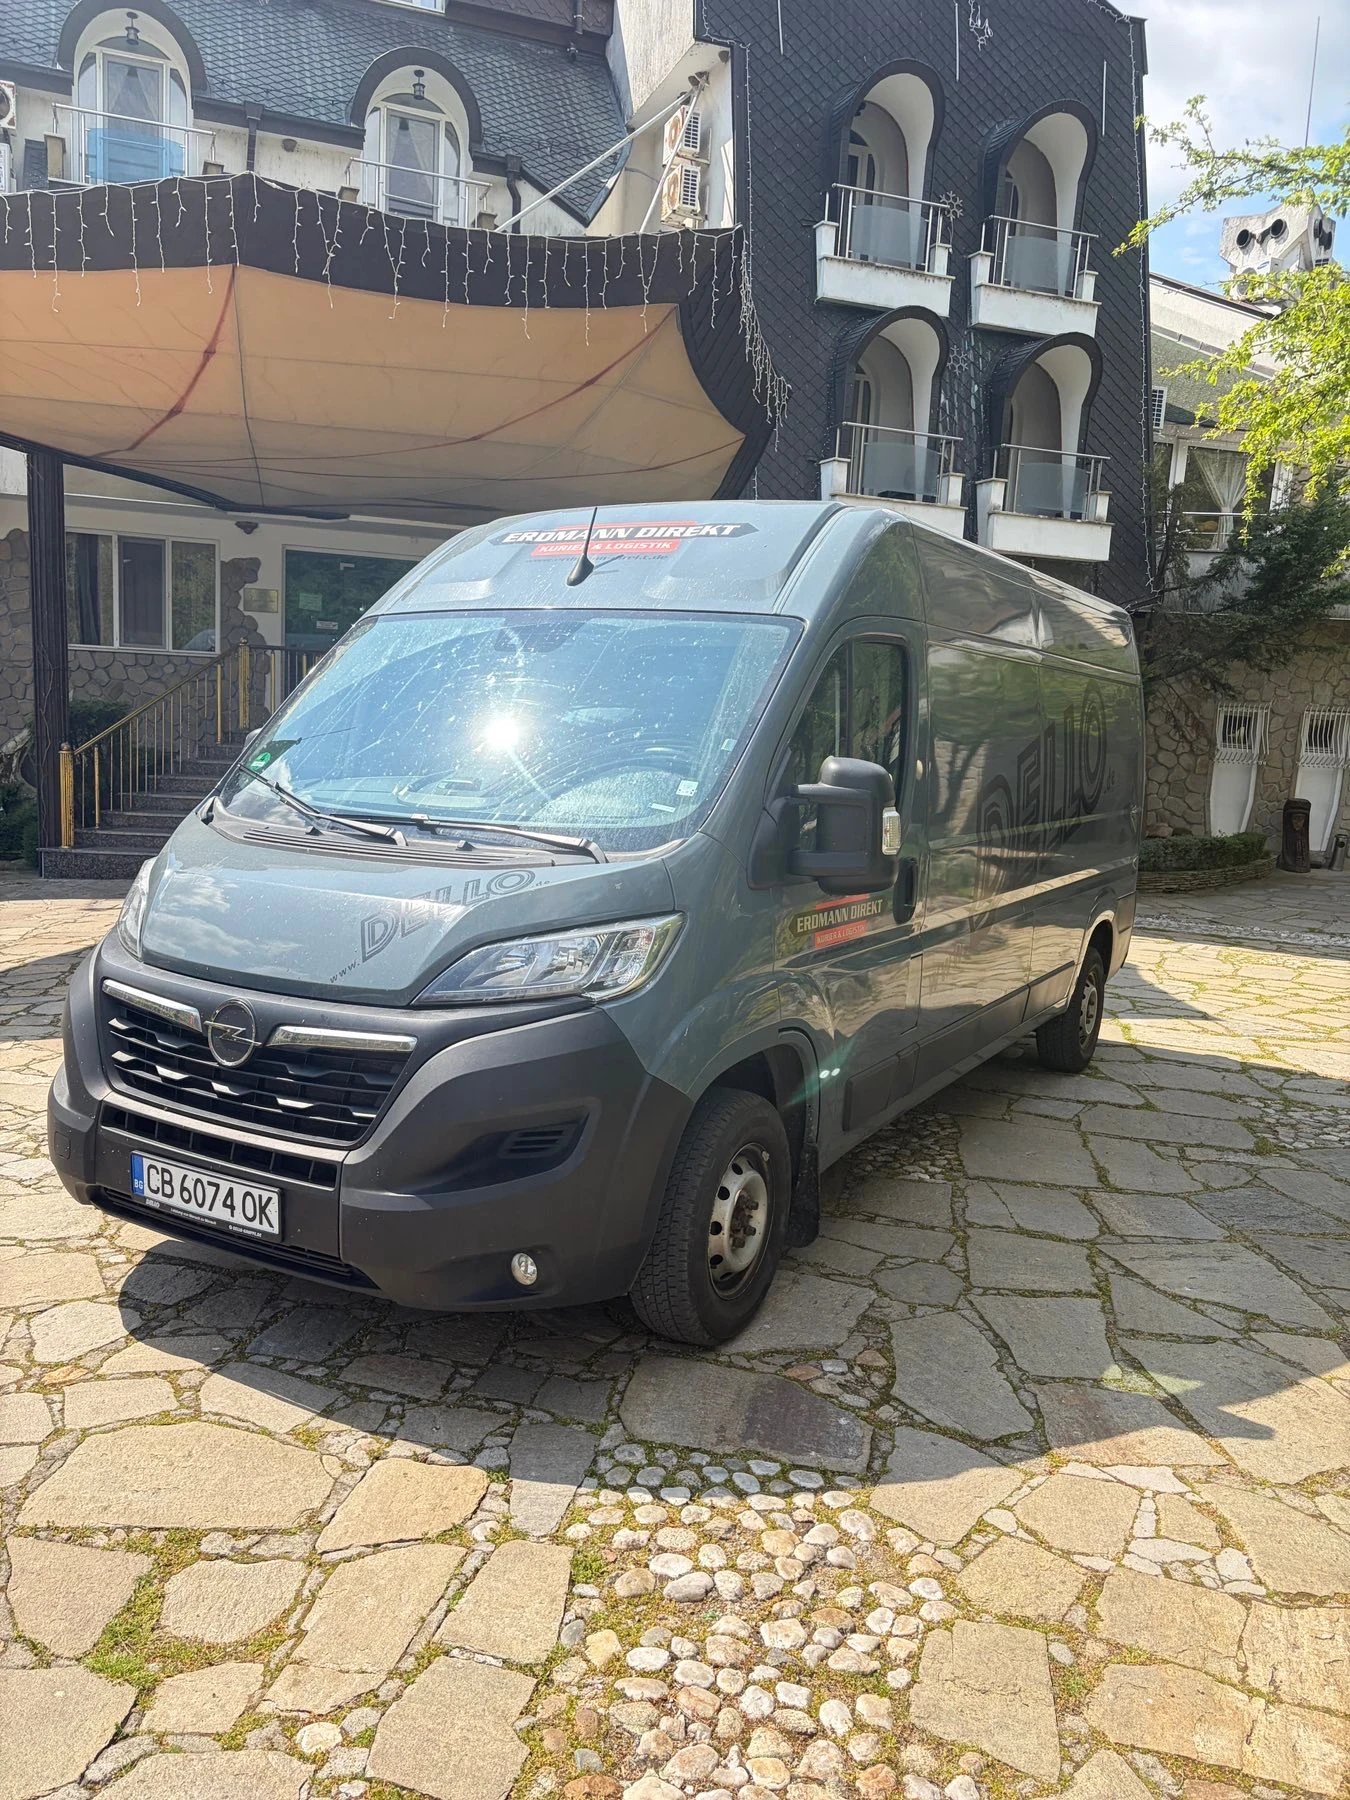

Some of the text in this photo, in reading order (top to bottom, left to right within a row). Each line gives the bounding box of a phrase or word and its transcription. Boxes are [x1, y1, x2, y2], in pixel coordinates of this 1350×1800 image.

[502, 525, 741, 544] ERDMANN DIREKT
[605, 541, 673, 550] LOGISTIK
[797, 899, 883, 933] ERDMANN DIREKT
[134, 1178, 143, 1190] BG
